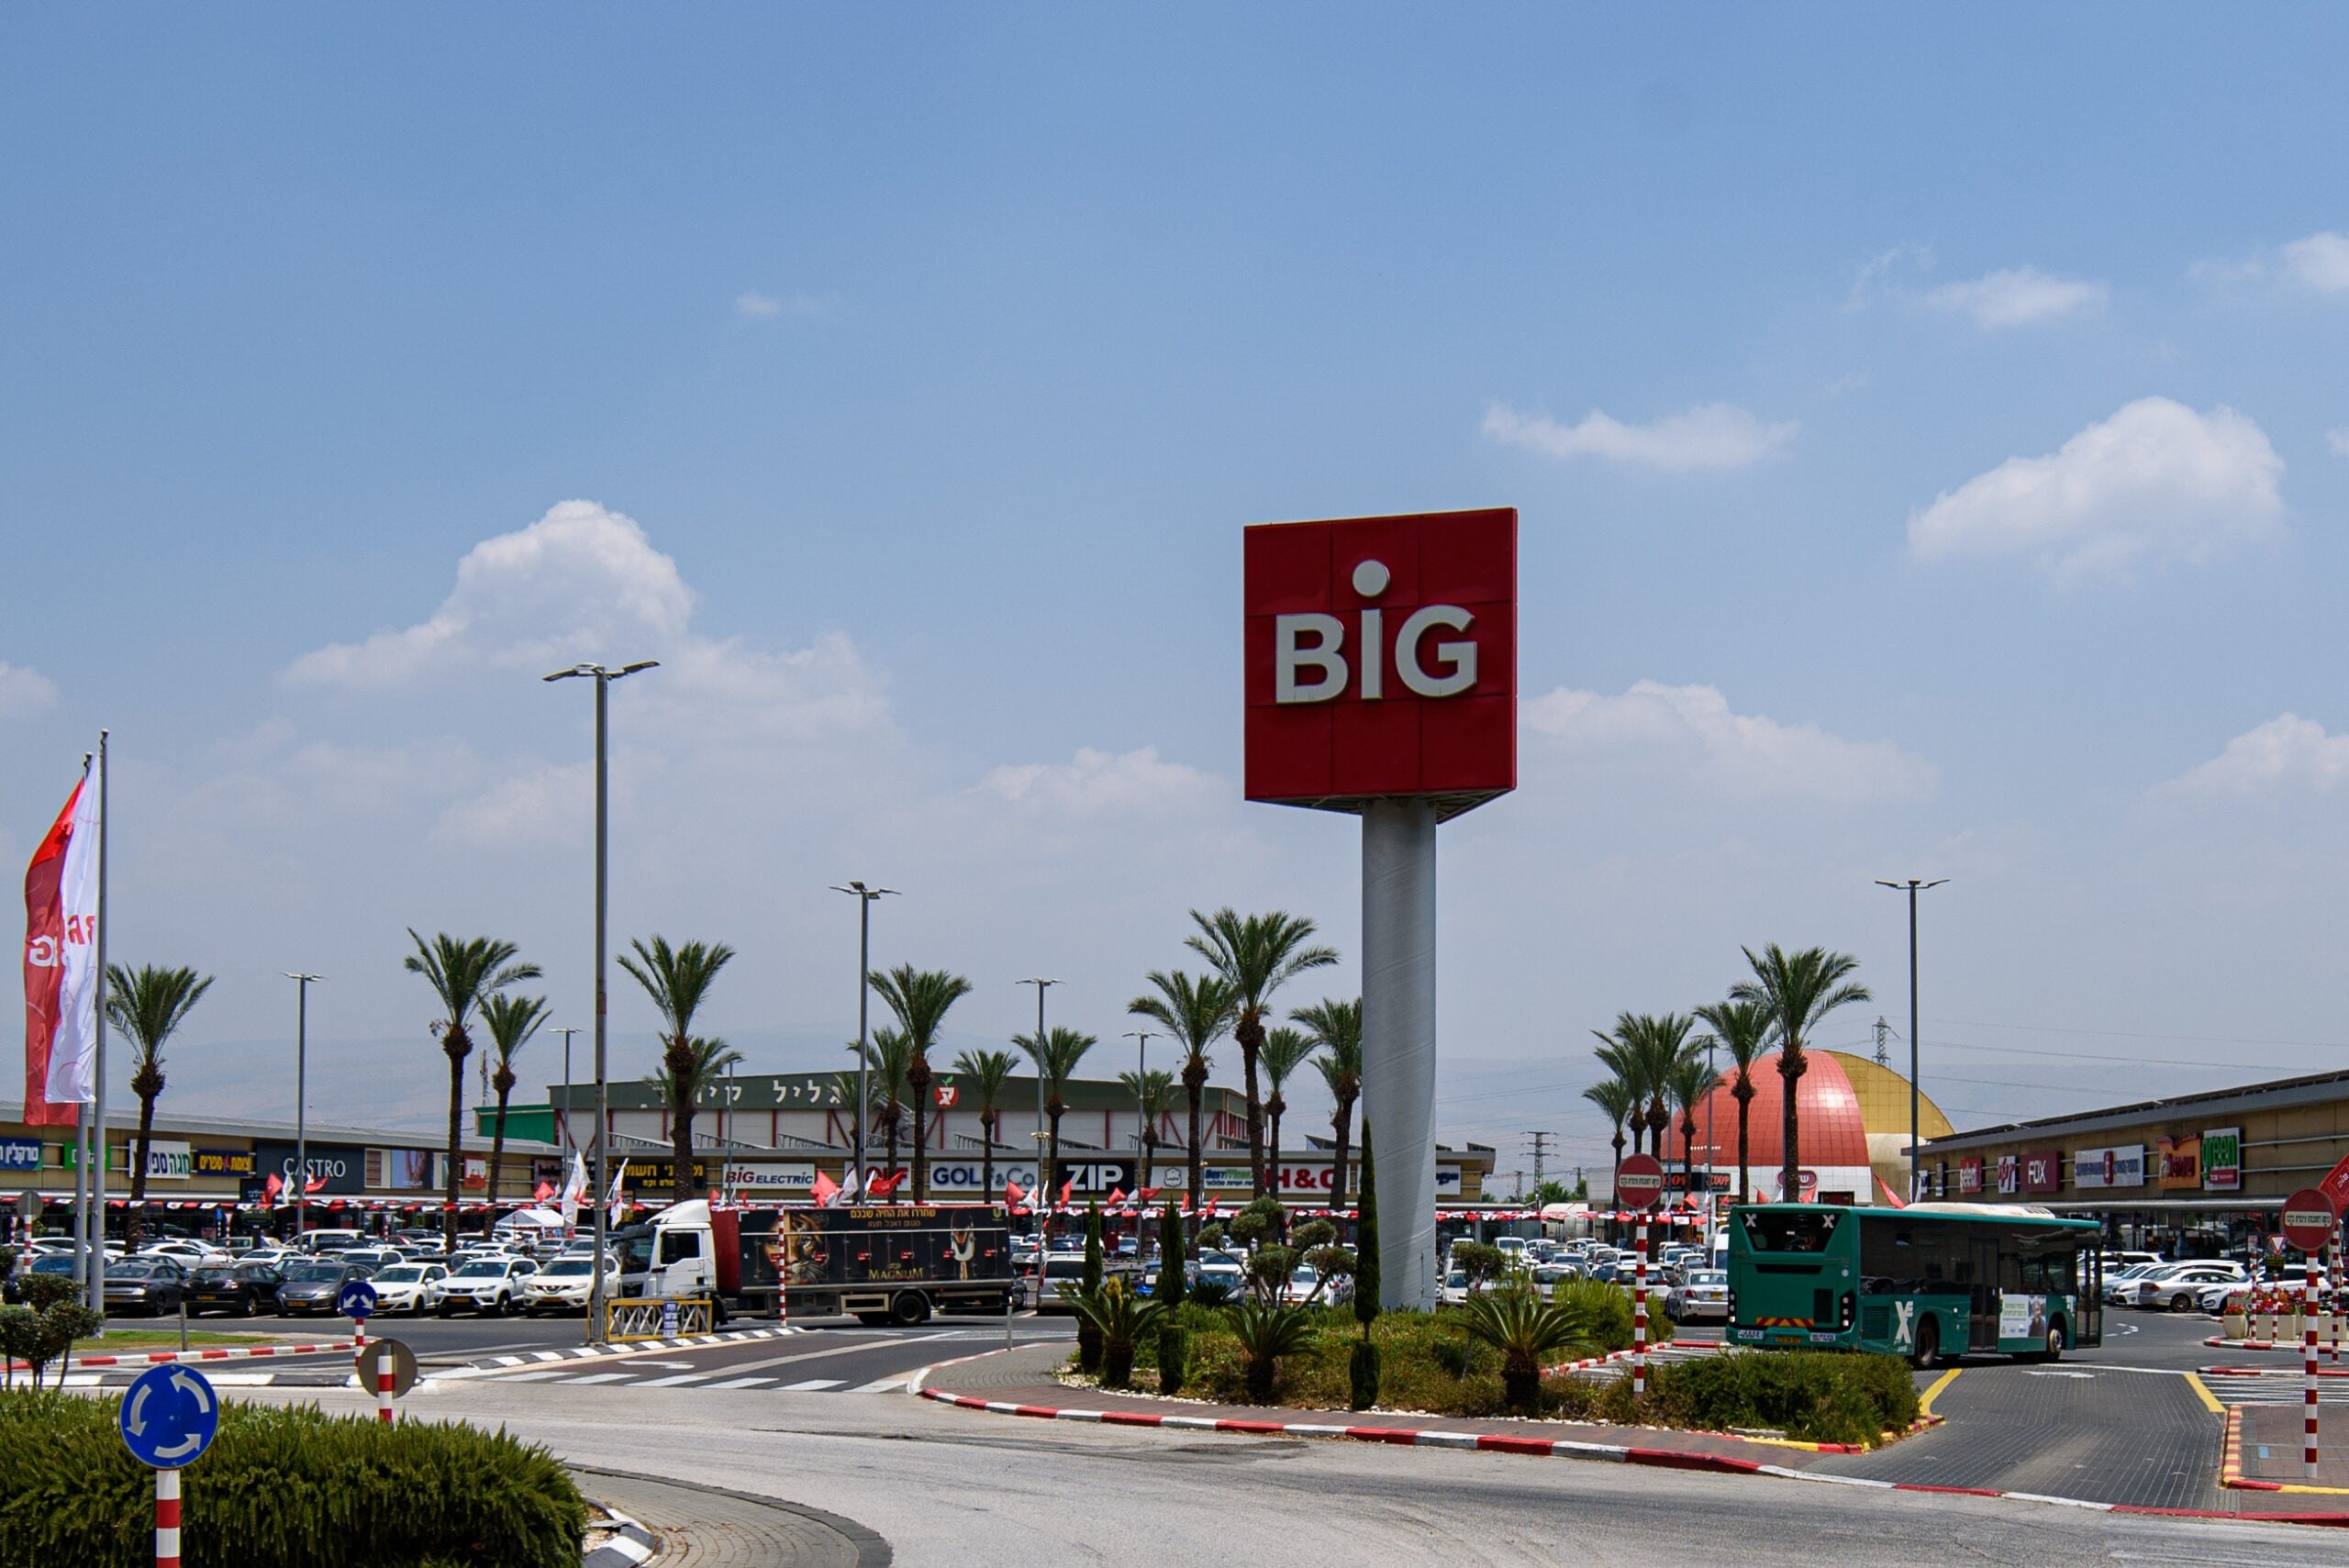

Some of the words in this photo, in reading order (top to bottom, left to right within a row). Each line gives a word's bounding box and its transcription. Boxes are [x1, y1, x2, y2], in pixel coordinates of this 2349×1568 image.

[773, 1079, 841, 1104] גליל
[168, 1153, 191, 1175] מגה
[199, 1154, 223, 1171] ספרים
[2202, 1134, 2237, 1180] green
[615, 1164, 658, 1177] חשמ
[663, 1164, 704, 1177] מני
[1066, 1164, 1123, 1191] ZIP
[2028, 1159, 2047, 1184] FOX
[850, 1209, 874, 1219] שבכם
[875, 1209, 896, 1218] החיה
[896, 1208, 910, 1218] את
[868, 1267, 923, 1280] MAGNUM
